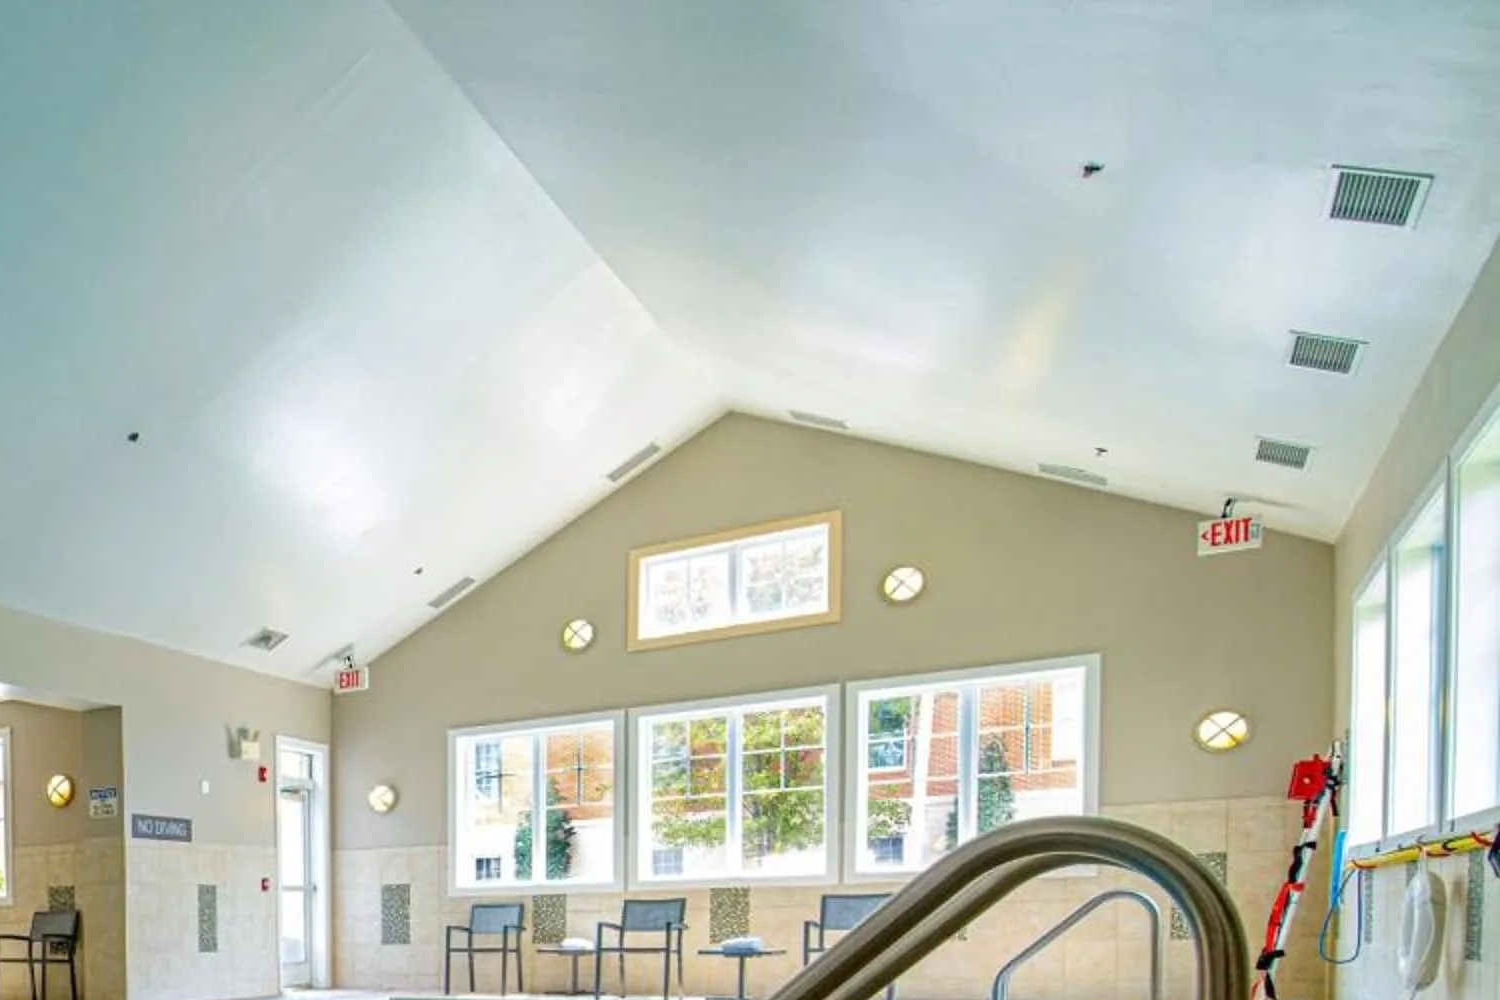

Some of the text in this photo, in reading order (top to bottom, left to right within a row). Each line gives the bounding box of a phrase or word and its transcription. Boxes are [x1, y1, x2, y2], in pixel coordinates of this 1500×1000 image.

[1211, 517, 1252, 546] EXIT
[339, 670, 360, 689] EXIT
[137, 819, 187, 837] NO DIVING
